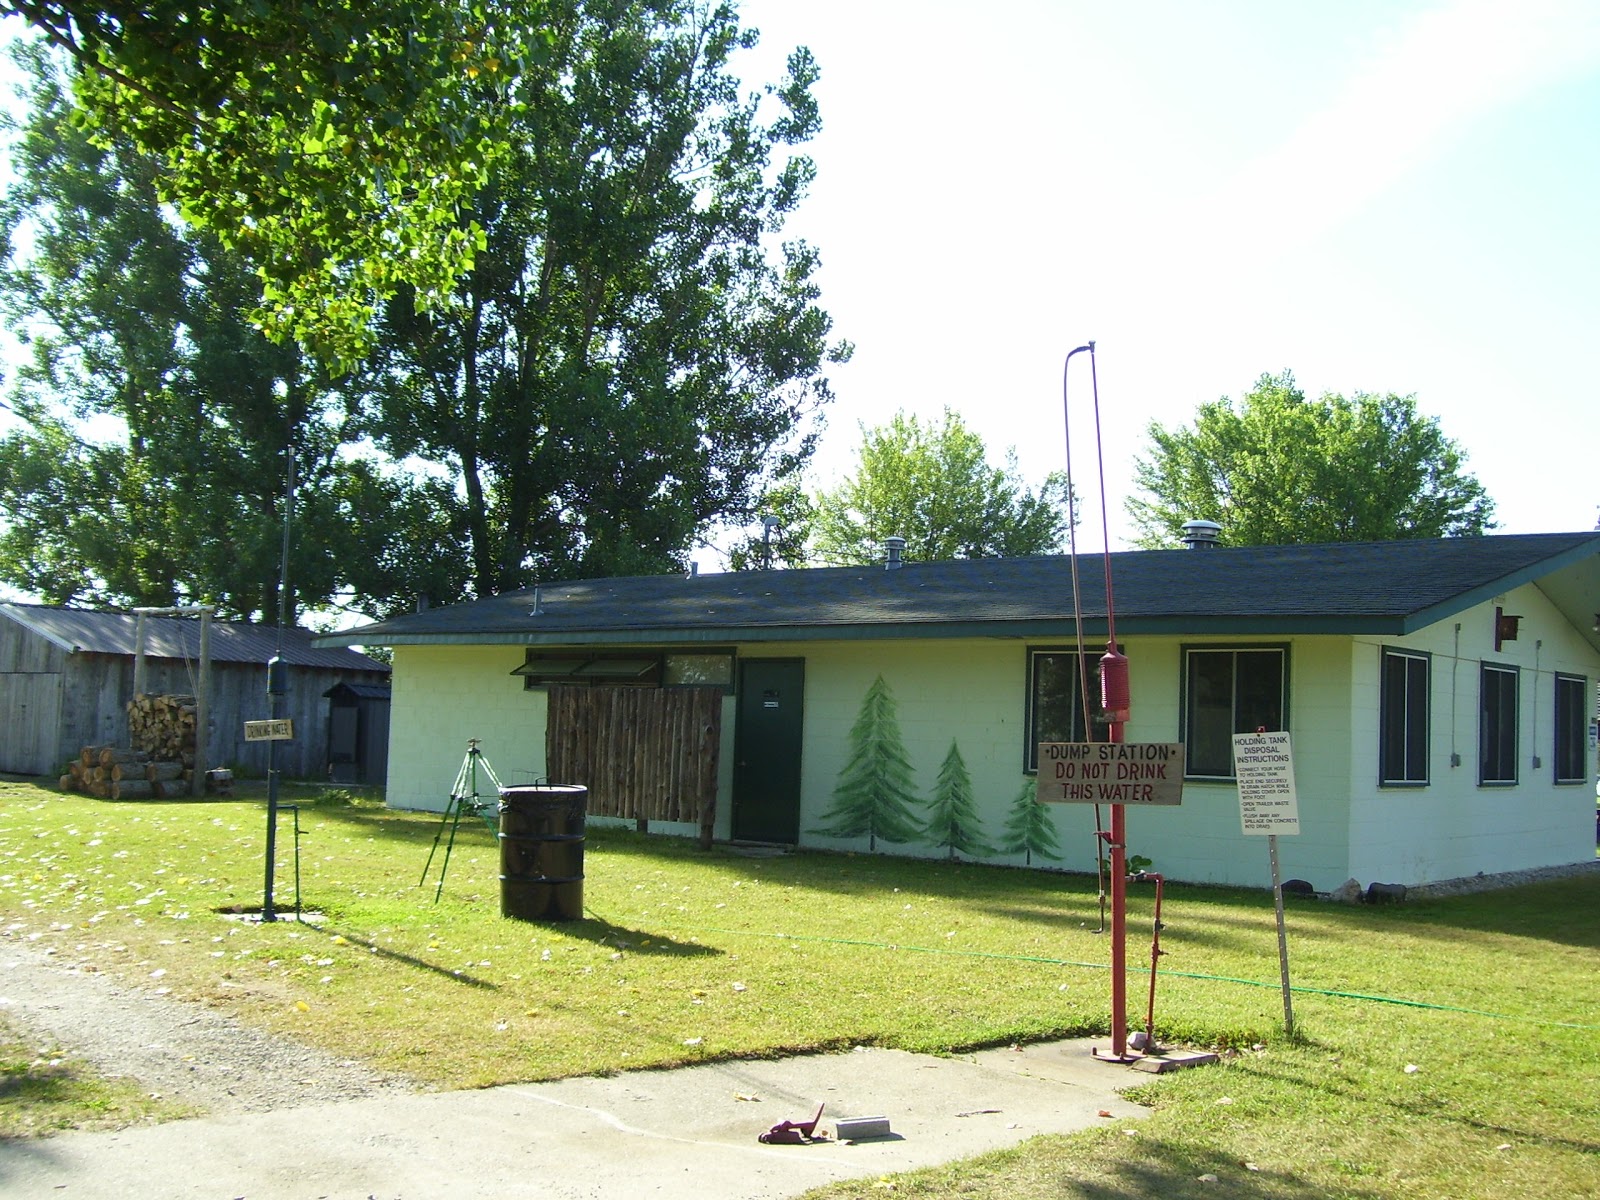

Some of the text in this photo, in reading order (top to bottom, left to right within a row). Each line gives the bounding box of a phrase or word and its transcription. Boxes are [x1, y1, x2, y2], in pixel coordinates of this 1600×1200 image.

[1234, 736, 1288, 746] HOLDING TANK
[1050, 744, 1169, 760] DUMP STATION
[1244, 746, 1280, 754] DISPOSAL
[1236, 754, 1290, 763] INSTRUCTIONS
[1055, 762, 1167, 780] DO NOT DRINK
[1061, 783, 1153, 801] THIS WATER
